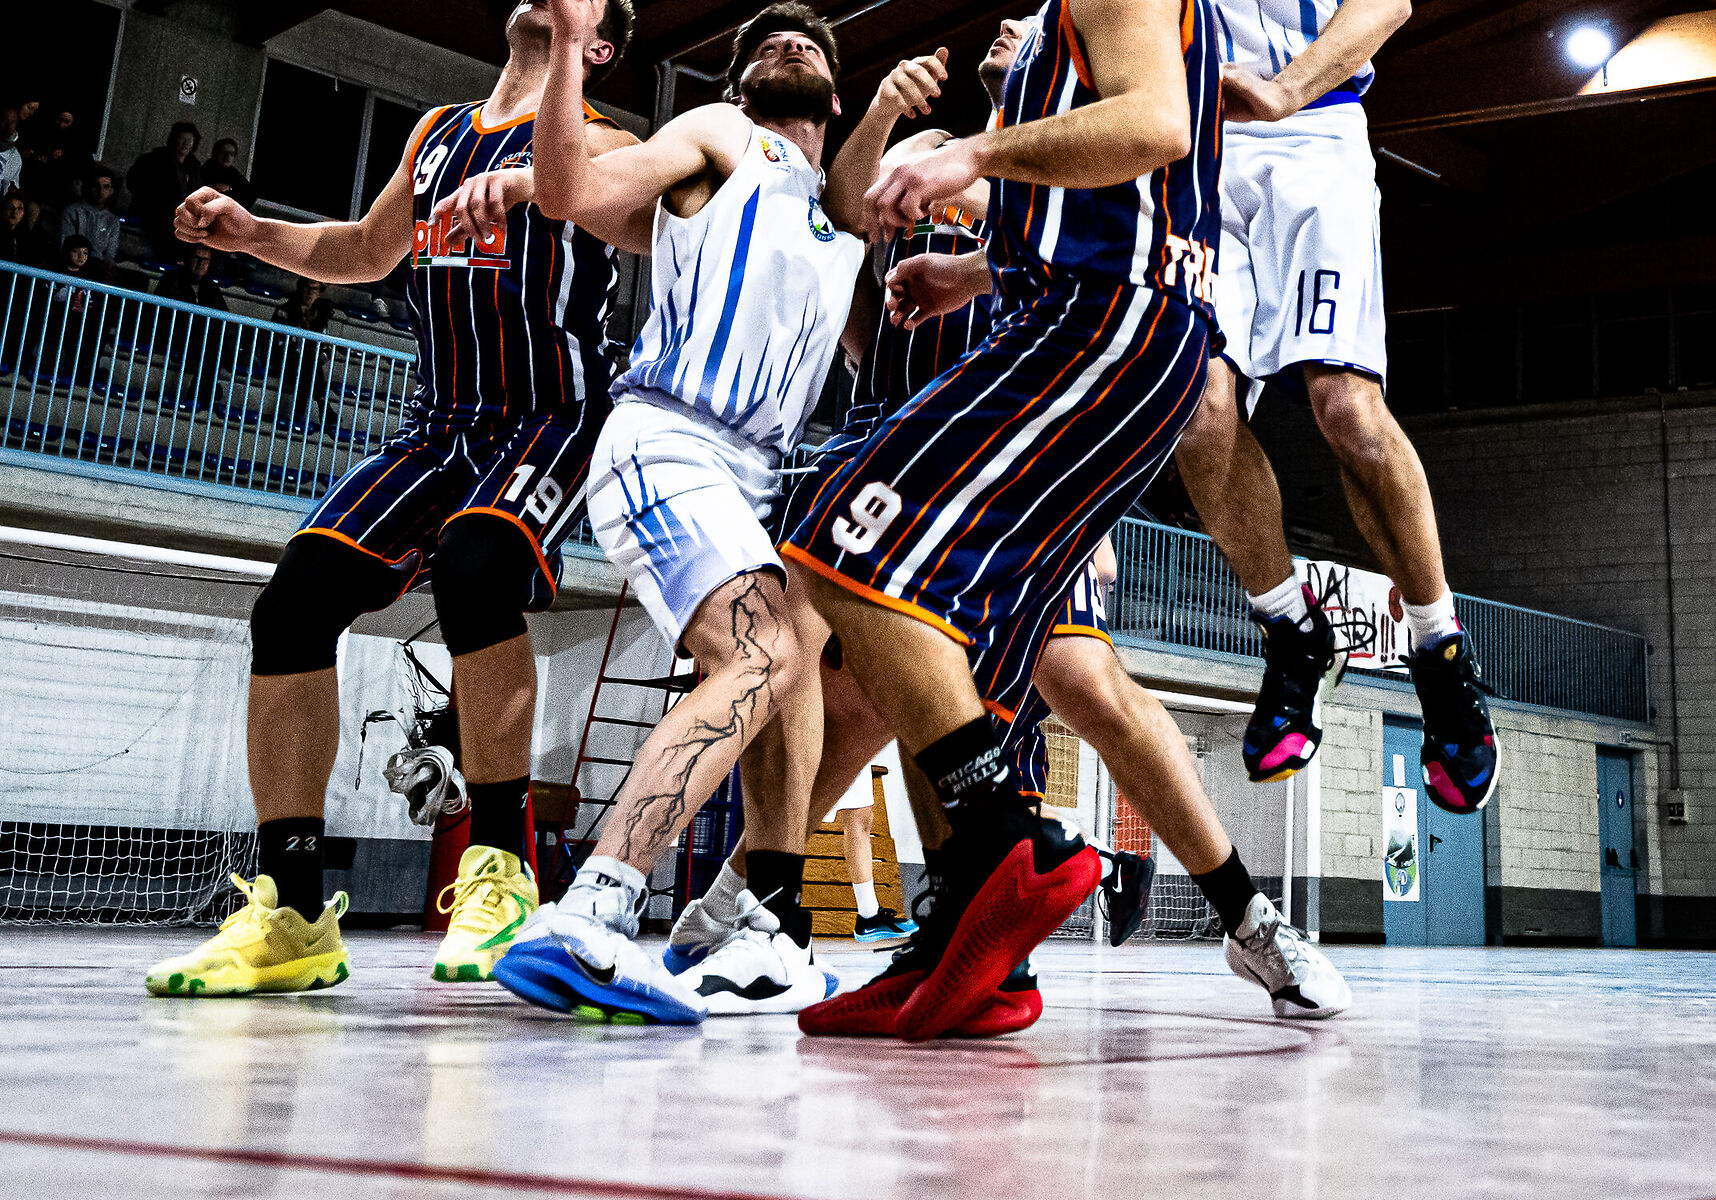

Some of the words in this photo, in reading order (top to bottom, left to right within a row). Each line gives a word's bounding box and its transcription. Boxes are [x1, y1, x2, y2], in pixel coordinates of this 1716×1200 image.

[1294, 269, 1341, 337] 16
[503, 464, 564, 525] 19
[831, 481, 903, 556] 9
[938, 746, 1001, 789] CHICAGO
[285, 835, 317, 852] 23
